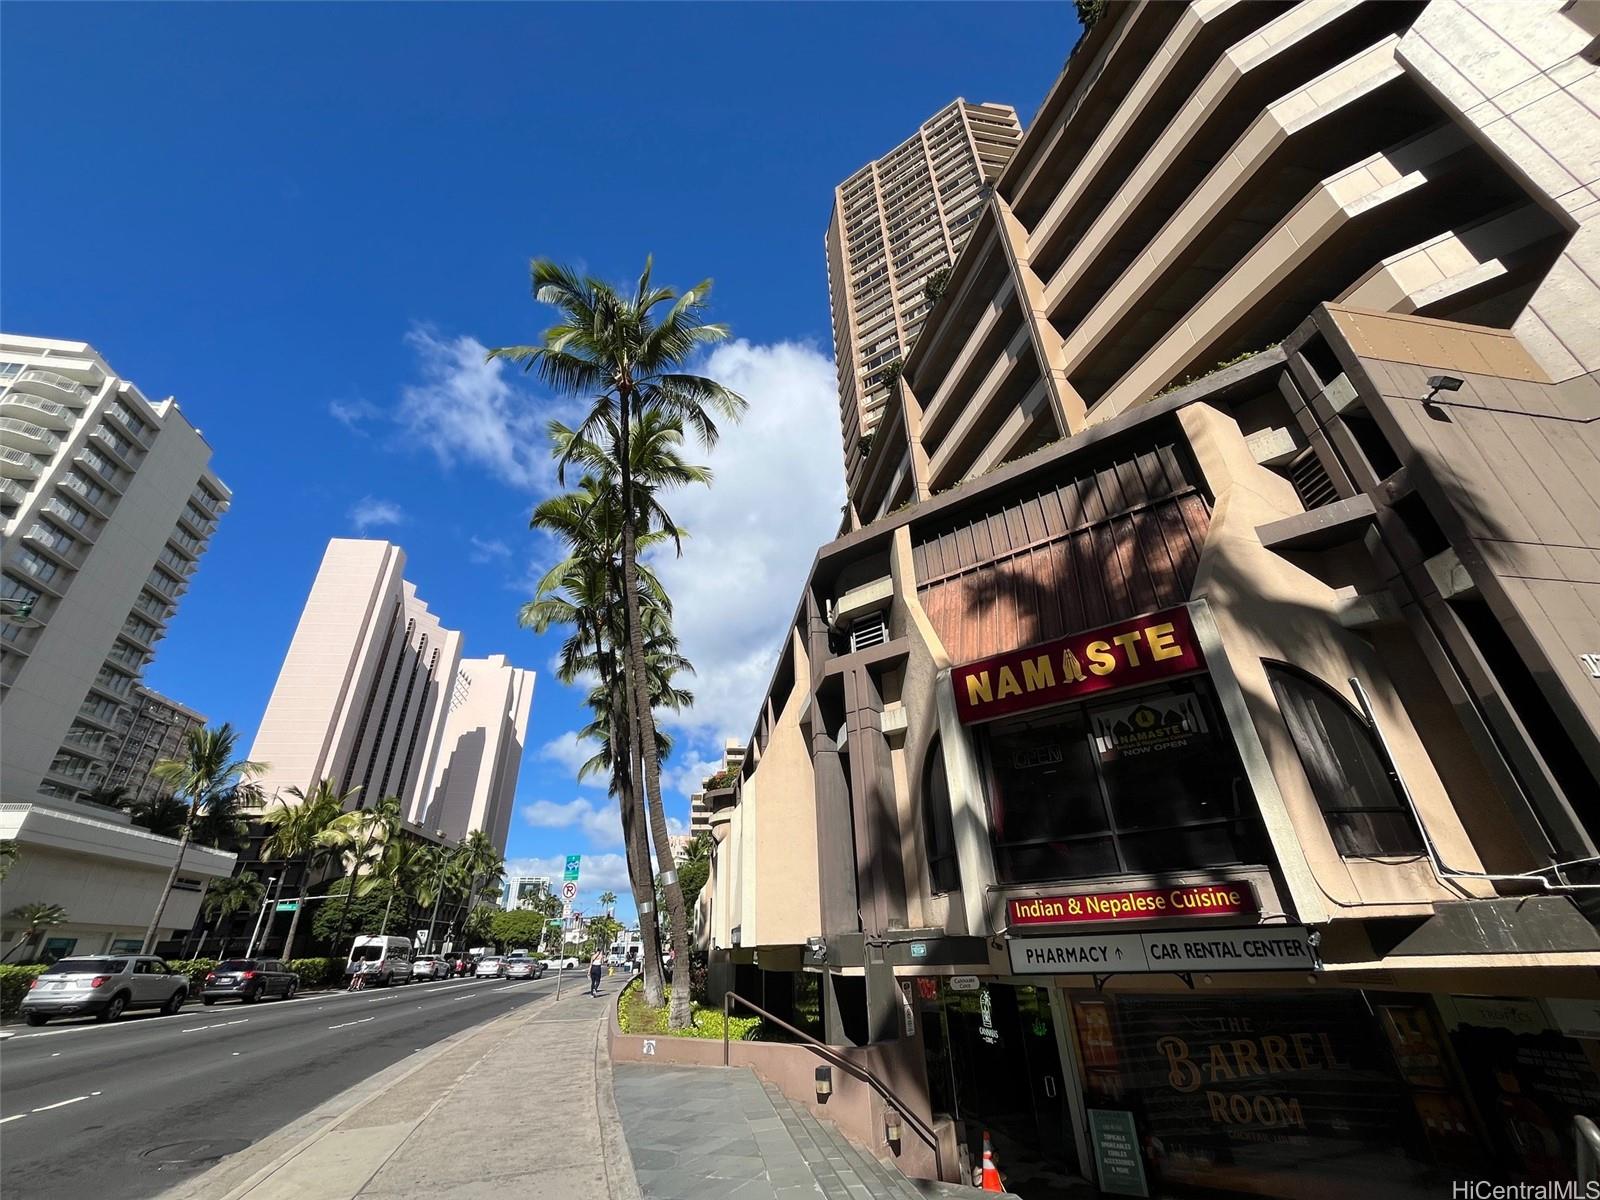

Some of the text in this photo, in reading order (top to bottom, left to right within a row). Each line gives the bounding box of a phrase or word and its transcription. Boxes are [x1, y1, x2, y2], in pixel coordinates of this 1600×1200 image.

[1120, 725, 1181, 744] NAMASTE
[1123, 745, 1151, 757] NOW
[1154, 739, 1188, 751] OPEN
[1015, 887, 1241, 918] Indian & Nepalese Cuisine
[1026, 946, 1108, 964] PHARMACY
[1151, 939, 1307, 960] CAR RENTAL CENTER
[1215, 1016, 1256, 1033] THE
[1156, 1032, 1351, 1093] BARREL
[1206, 1090, 1307, 1129] ROOM
